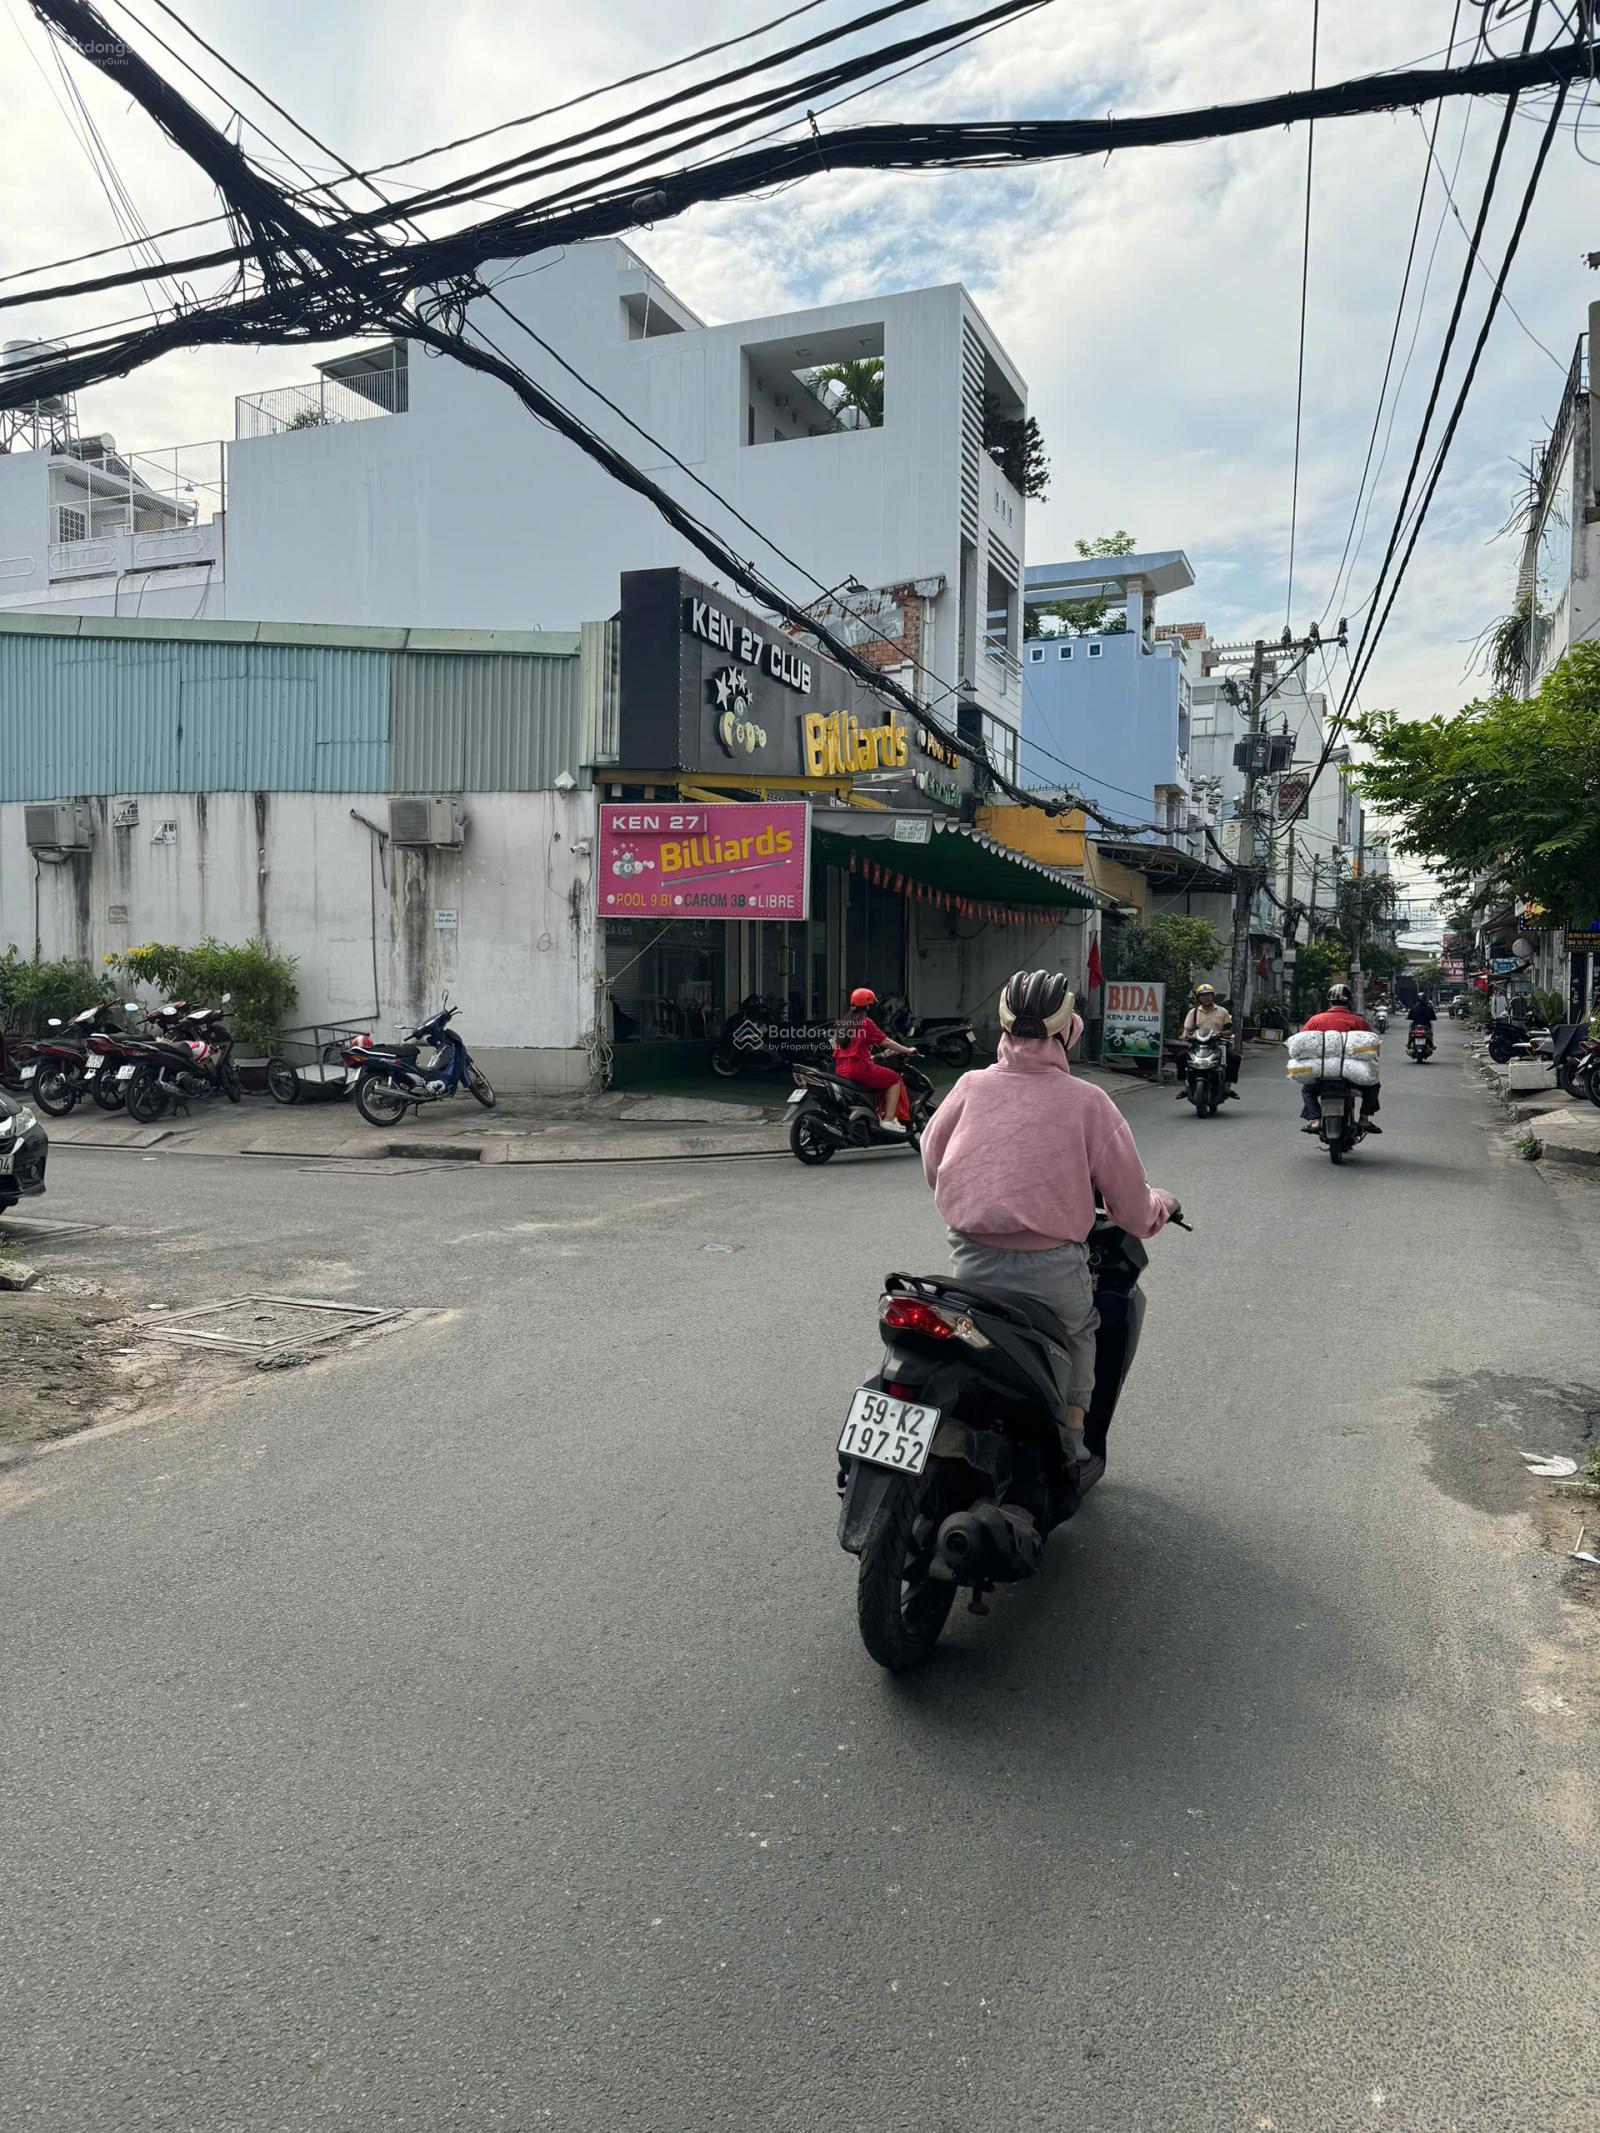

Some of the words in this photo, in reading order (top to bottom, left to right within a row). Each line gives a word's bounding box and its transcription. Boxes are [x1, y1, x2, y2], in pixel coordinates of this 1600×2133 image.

[693, 597, 734, 652] KEN
[741, 626, 763, 665] 27
[770, 644, 811, 694] CLUB
[802, 709, 908, 777] Billiards
[612, 815, 660, 830] KEN
[670, 815, 699, 830] 27
[660, 824, 793, 873] Billiards
[616, 893, 646, 907] POOL
[651, 894, 657, 907] 9
[661, 894, 672, 907] BI
[684, 893, 727, 907] CAROM
[731, 894, 746, 907] 3B
[758, 895, 794, 908] LIBRE
[1106, 1013, 1123, 1021] KEN
[1107, 985, 1159, 1012] BIDA
[861, 1394, 925, 1437] 59-K2
[846, 1423, 924, 1470] 197.52
